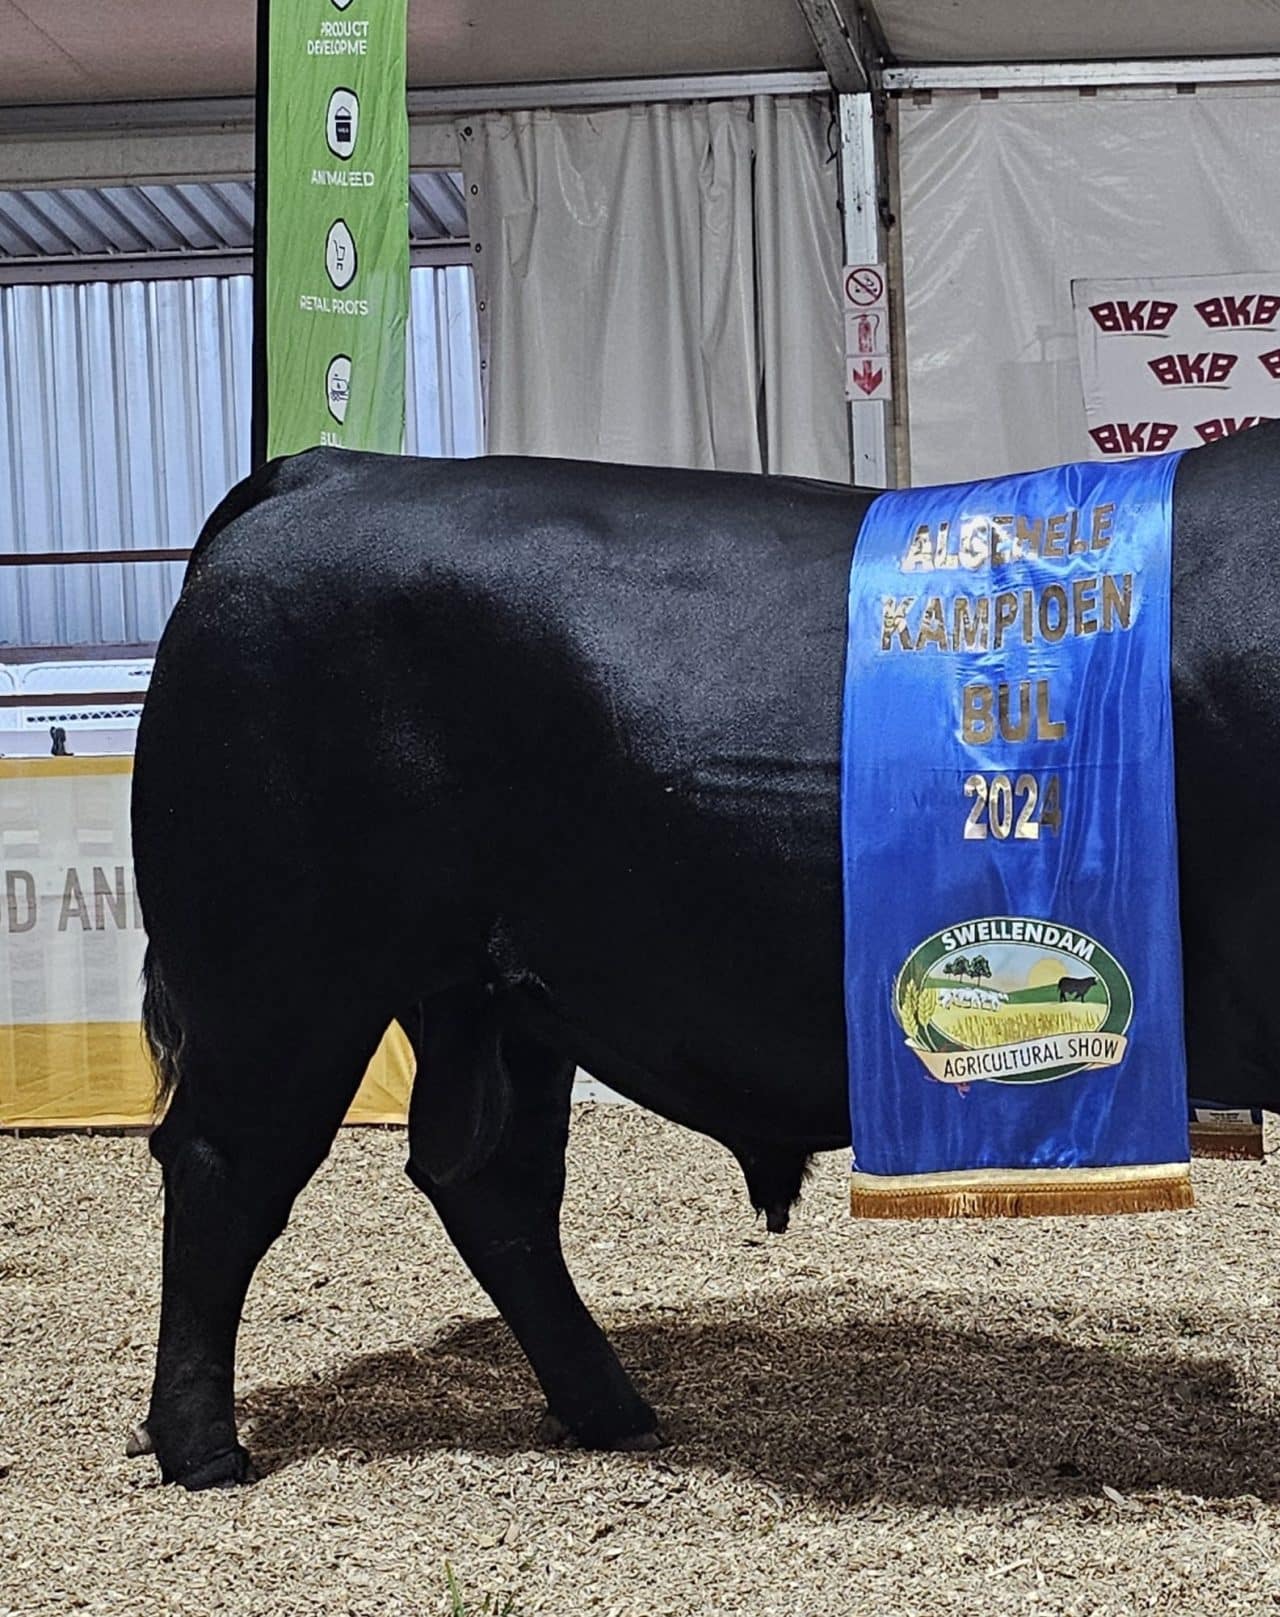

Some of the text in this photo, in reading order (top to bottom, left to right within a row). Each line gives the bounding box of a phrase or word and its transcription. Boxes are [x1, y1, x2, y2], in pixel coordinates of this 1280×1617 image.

[1088, 300, 1178, 331] BKB
[1147, 352, 1238, 385] BKB
[1088, 422, 1178, 454] BKB
[881, 571, 1134, 652] KAMPIOEN
[962, 679, 1066, 744] BUL
[963, 774, 1062, 839] 2024
[0, 868, 37, 933] D
[941, 921, 1095, 961] SWELLENDAM
[944, 1039, 1118, 1078] AGRICULTURAL SHOW
